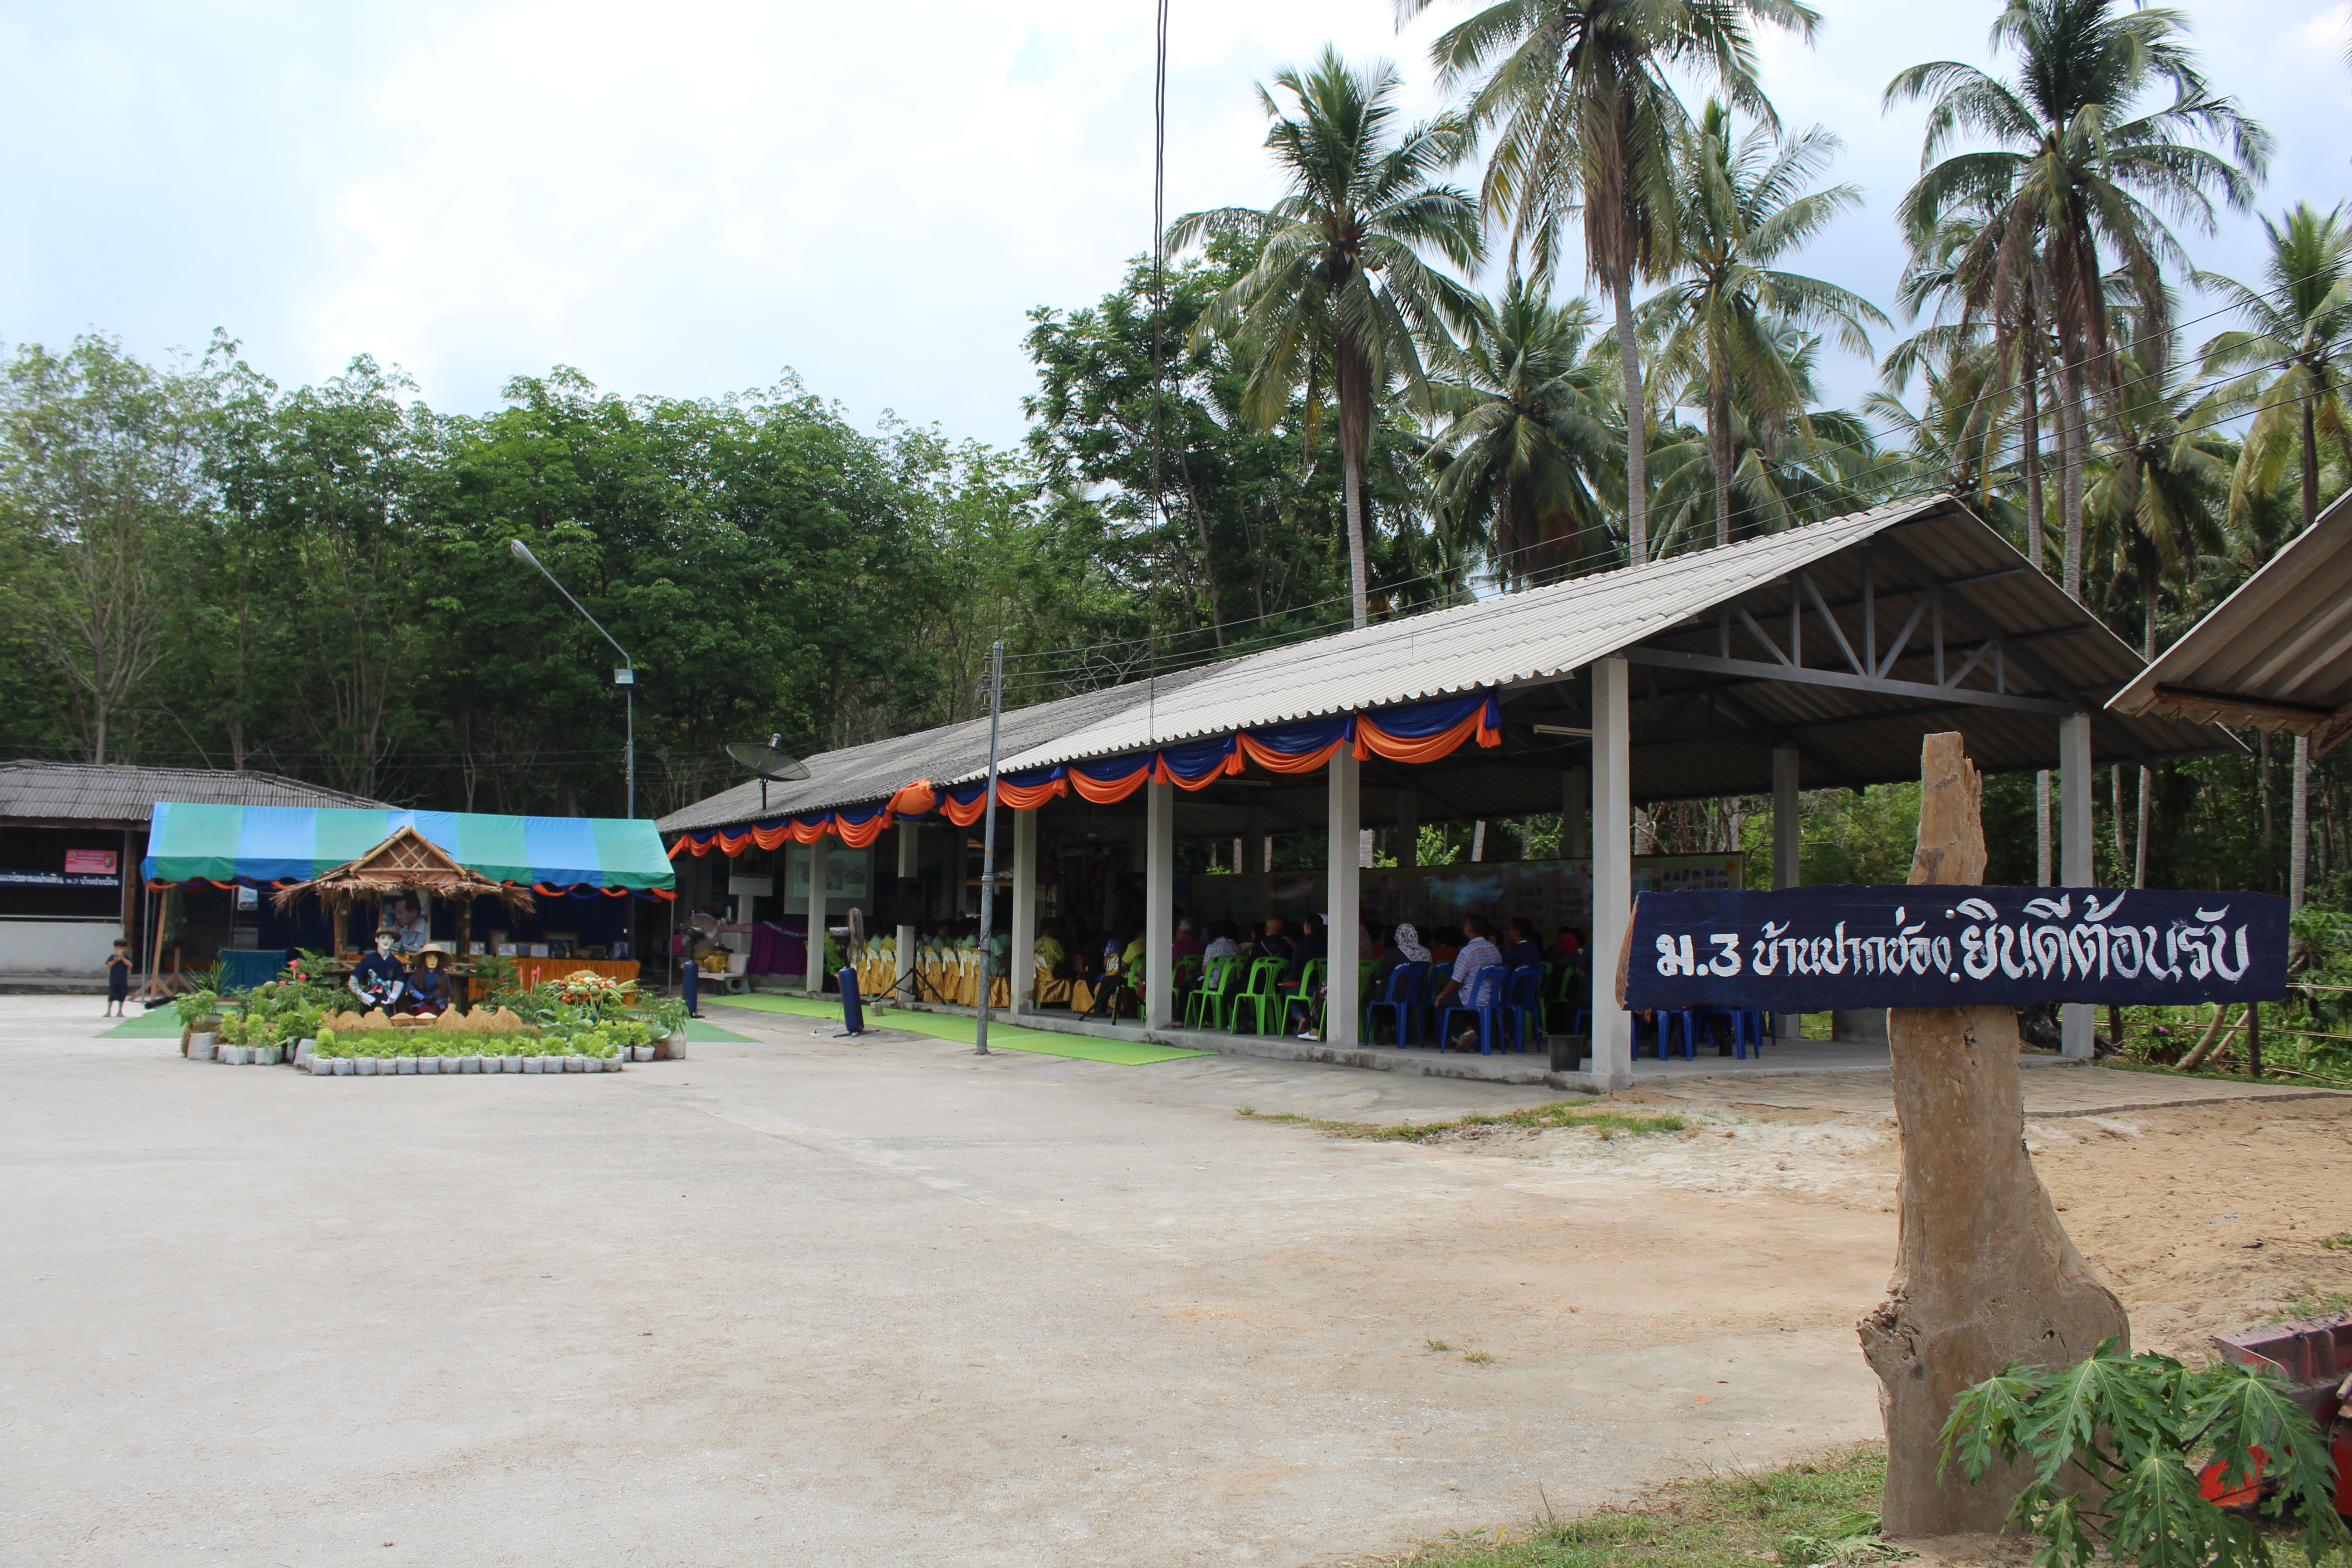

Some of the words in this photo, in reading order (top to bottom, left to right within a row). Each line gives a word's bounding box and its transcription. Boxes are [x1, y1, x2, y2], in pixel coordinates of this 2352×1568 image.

[0, 872, 64, 884] แม่ของแผ่นดิน
[1656, 933, 1742, 977] ม.3
[1752, 906, 1952, 976] บ้านปากช่อง
[1956, 889, 2250, 985] ยินดีต้อนรับ
